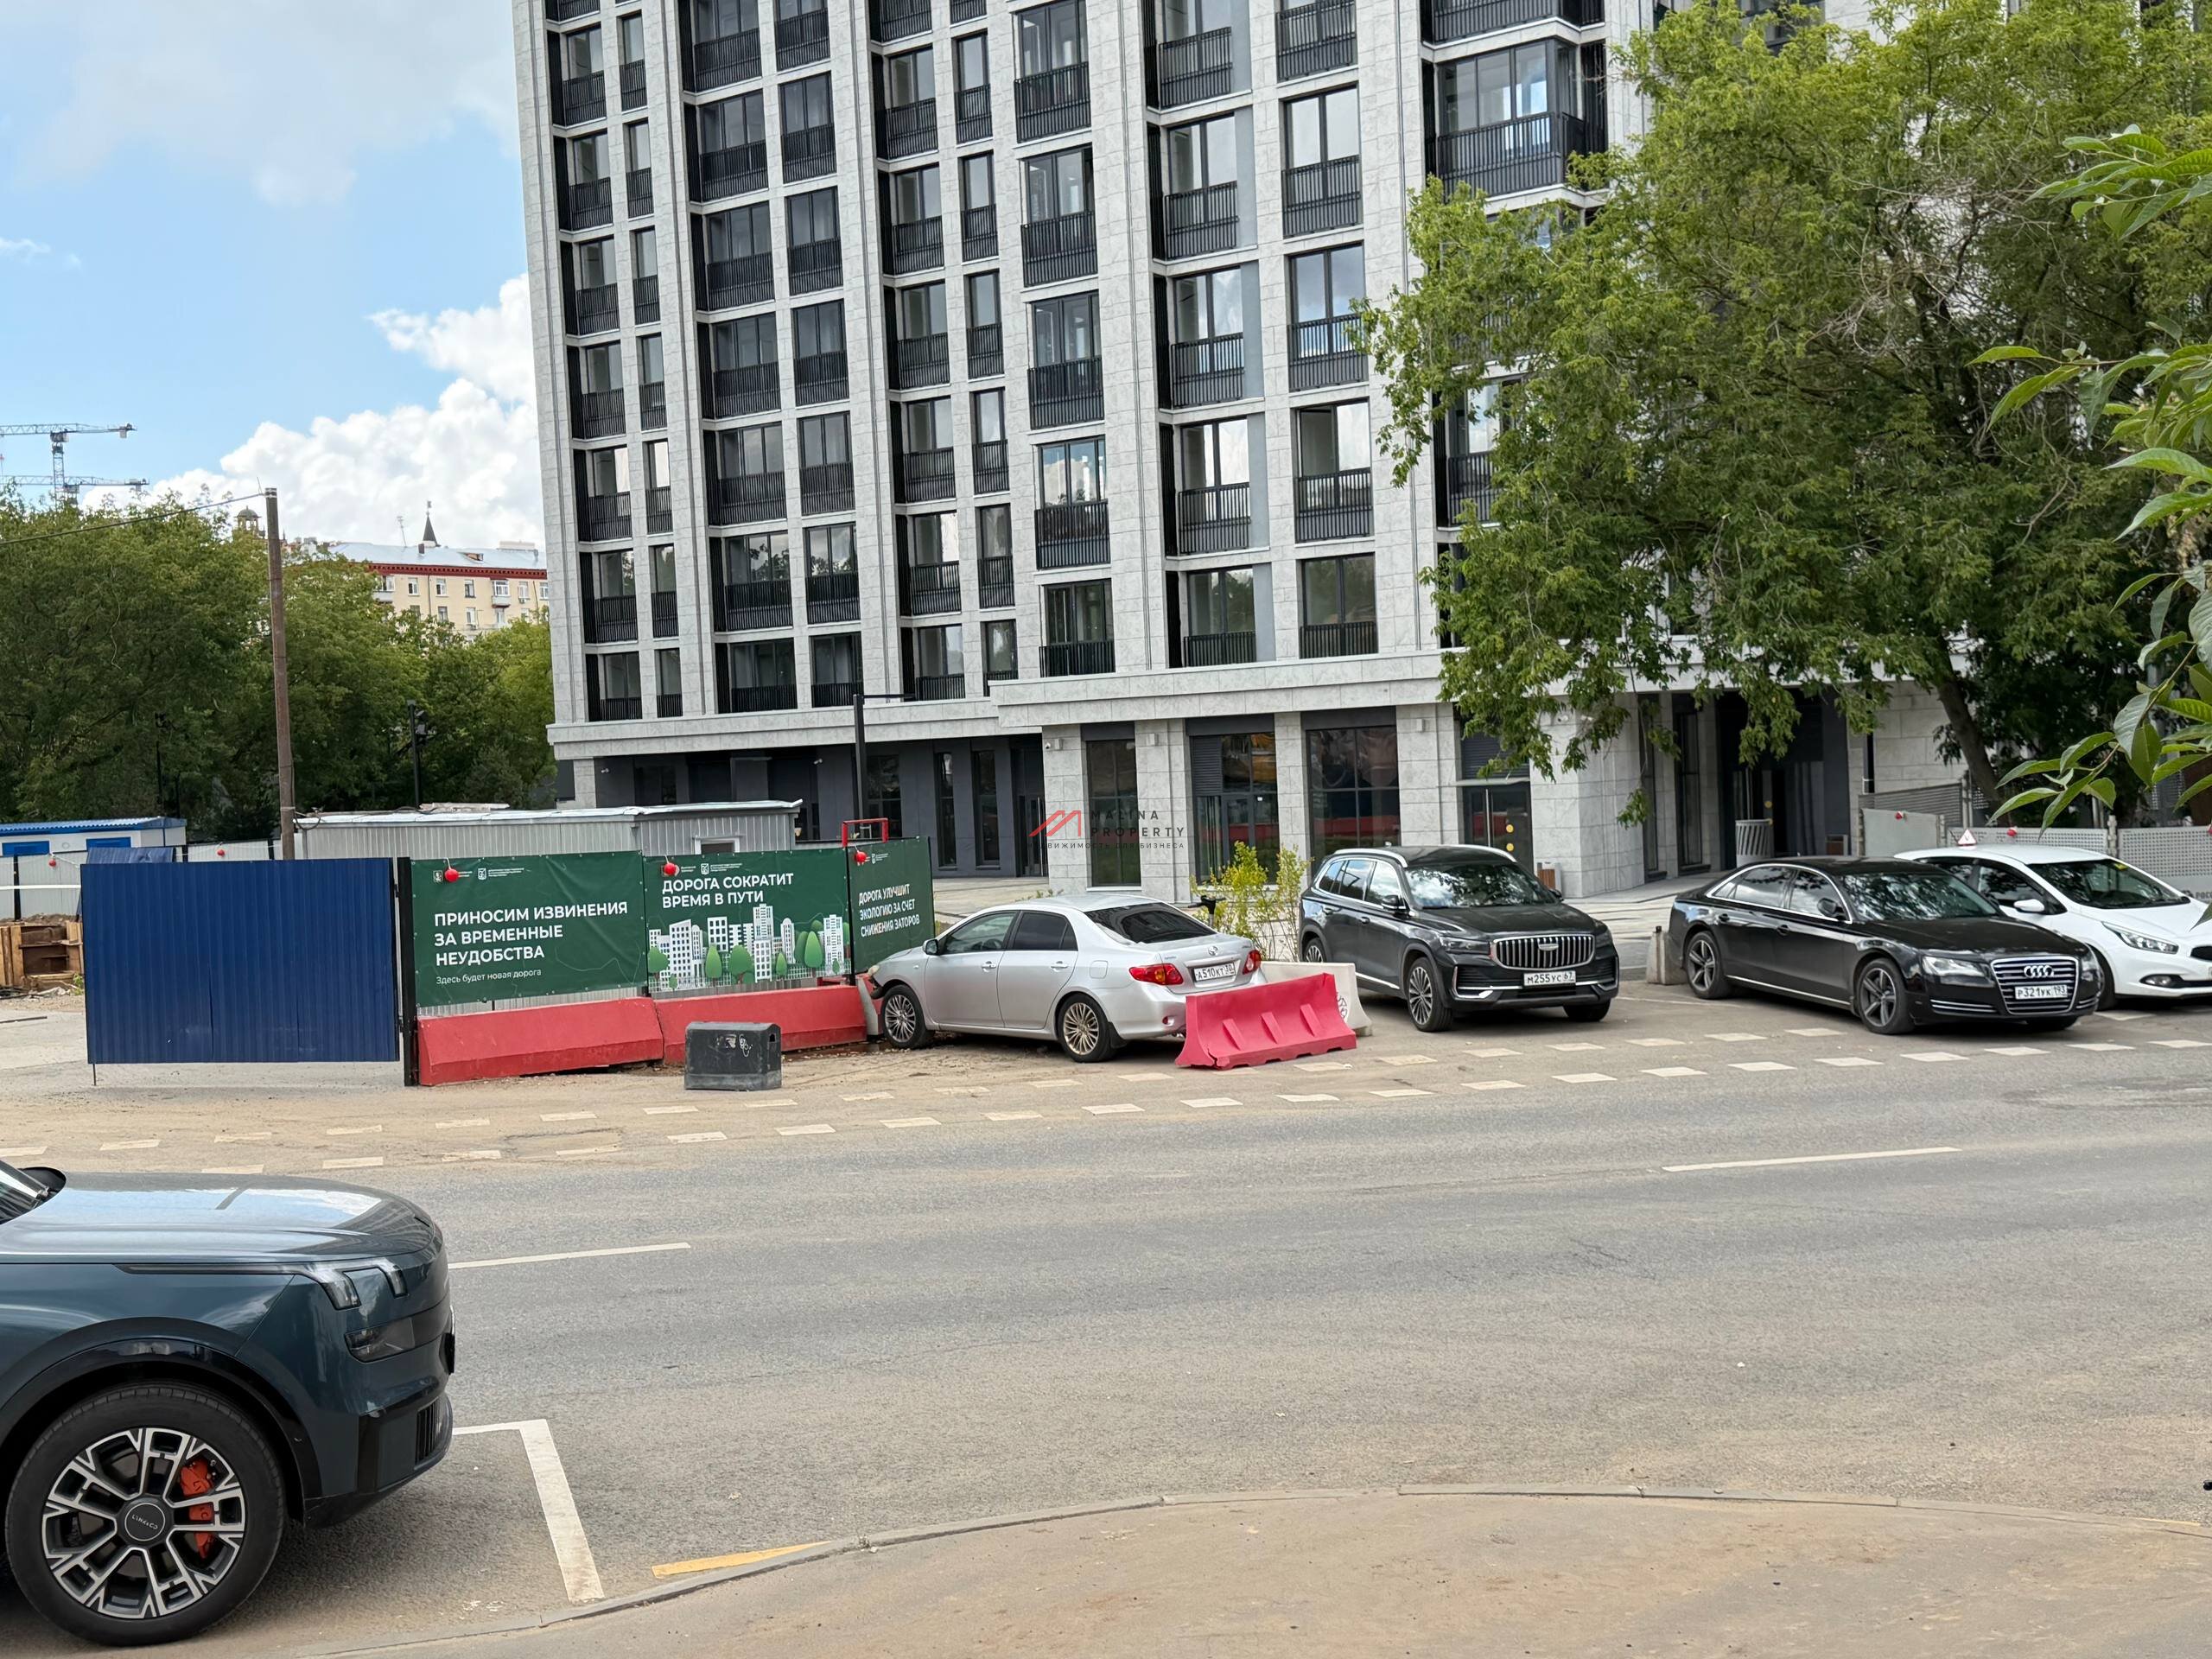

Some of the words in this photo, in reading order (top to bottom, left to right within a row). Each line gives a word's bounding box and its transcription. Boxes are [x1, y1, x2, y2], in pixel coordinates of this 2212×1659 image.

[662, 877, 720, 894] ДОРОГА
[722, 873, 794, 888] СОКРАТИТ
[858, 888, 882, 906] ДОРОГА
[882, 883, 911, 900] УЛУЧШИТ
[662, 893, 711, 909] ВРЕМЯ
[715, 893, 724, 906] В
[728, 890, 764, 905] ПУТИ
[859, 903, 893, 921] ЭКОЛОГИЮ
[893, 901, 901, 913] ЗА
[901, 899, 916, 912] СЧЕТ
[434, 907, 529, 927] ПРИНОСИМ
[534, 901, 628, 920] ИЗВИНЕНИЯ
[434, 932, 457, 947] ЗА
[461, 925, 563, 944] ВРЕМЕННЫЕ
[861, 919, 894, 938] СНИЖЕНИЯ
[894, 913, 920, 930] ЗАТОРОВ
[435, 945, 545, 966] НЕУДОБСТВА
[435, 976, 461, 985] Здесь
[462, 973, 486, 983] будет
[486, 970, 512, 980] новая
[512, 969, 542, 979] дорога
